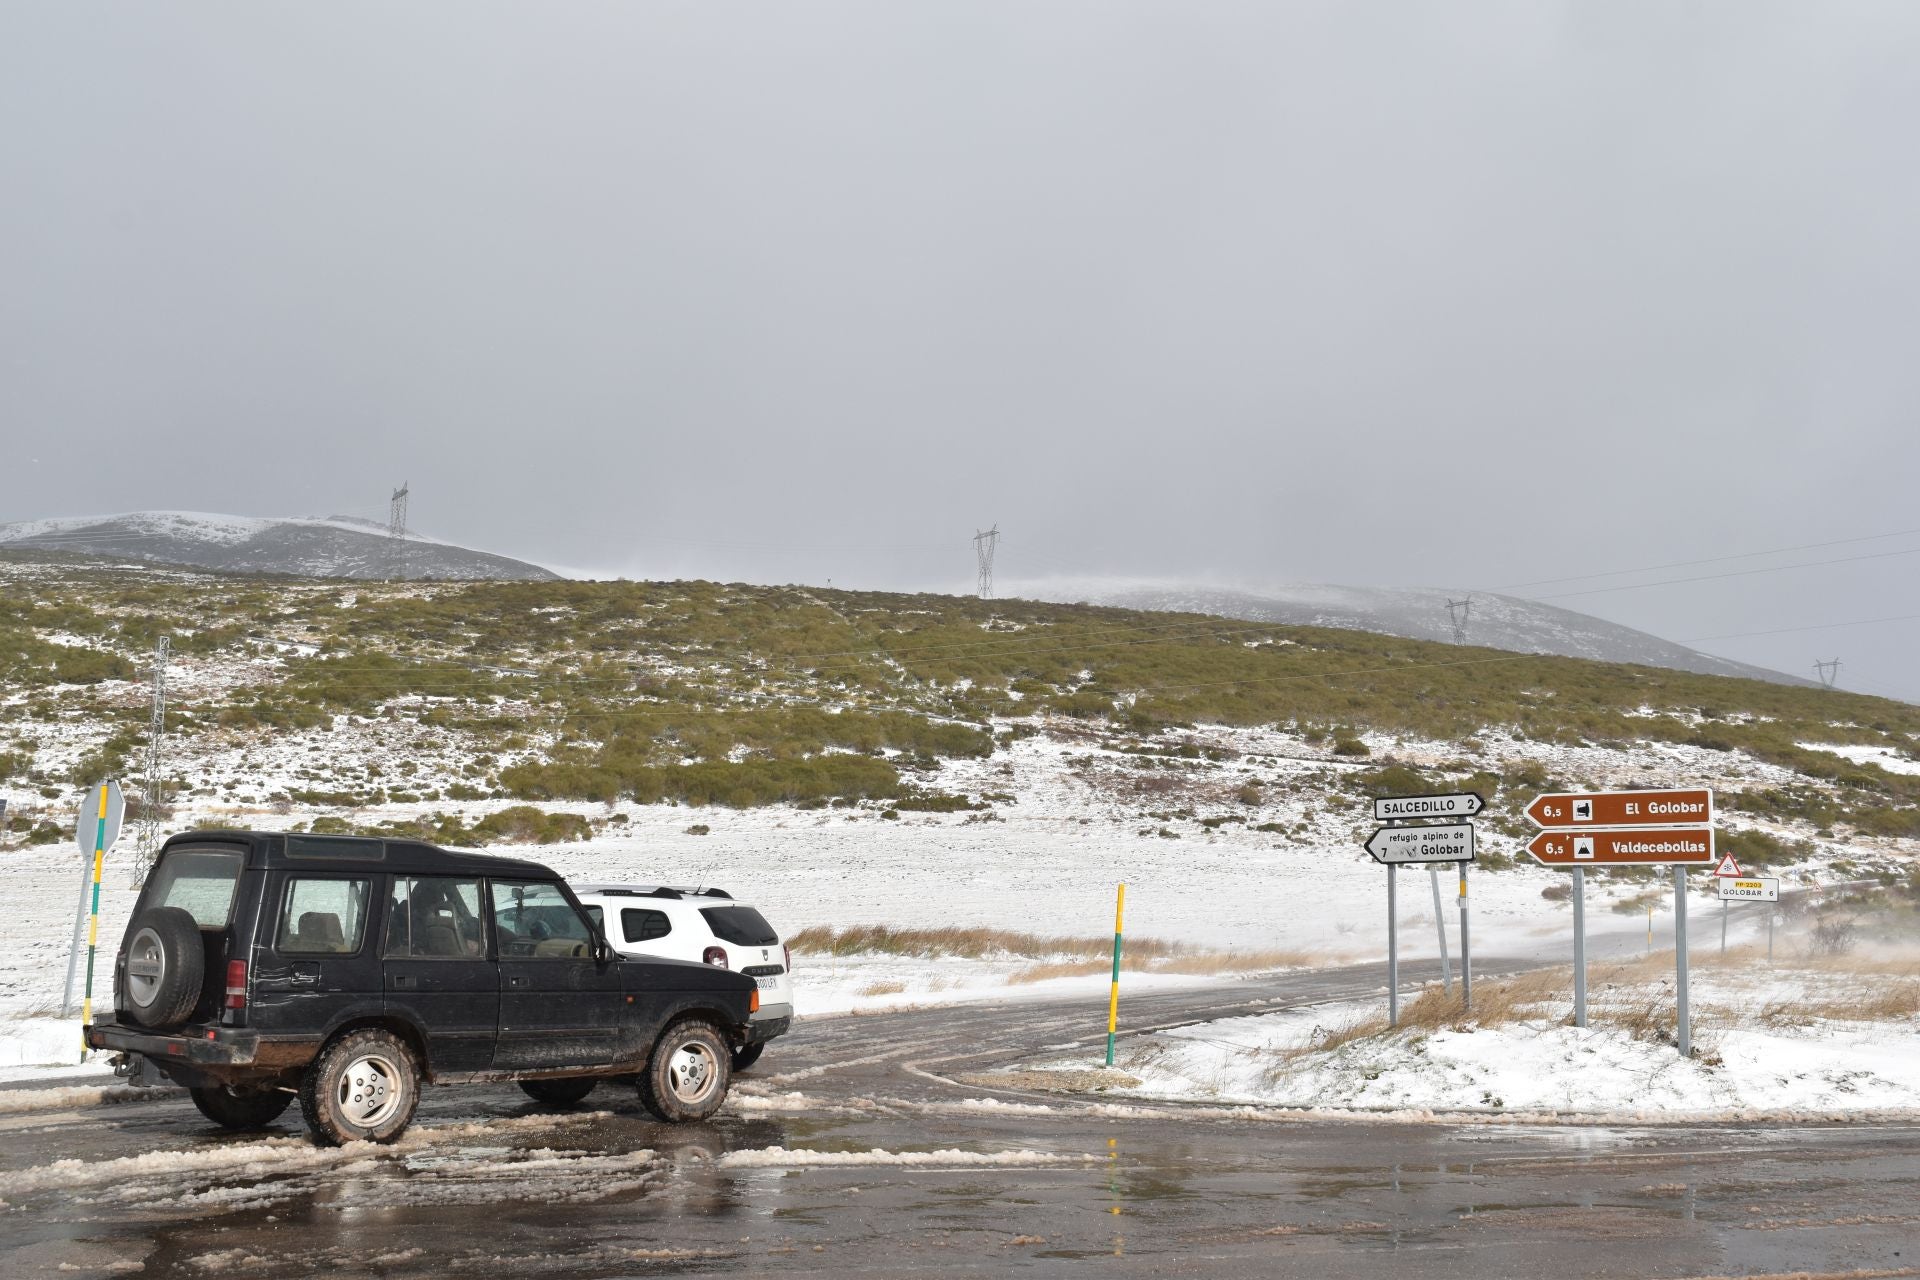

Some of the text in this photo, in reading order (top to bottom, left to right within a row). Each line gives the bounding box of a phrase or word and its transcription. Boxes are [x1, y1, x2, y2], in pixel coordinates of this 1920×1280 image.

[1384, 799, 1475, 814] SALCEDILLO 2
[1543, 801, 1705, 818] 6,5 El Golobar
[1389, 831, 1464, 842] refugio alpino de
[1381, 844, 1465, 858] 7 Golobar
[1545, 840, 1706, 855] 6,5 Valdecebollas
[1723, 888, 1762, 896] GOLOBAR
